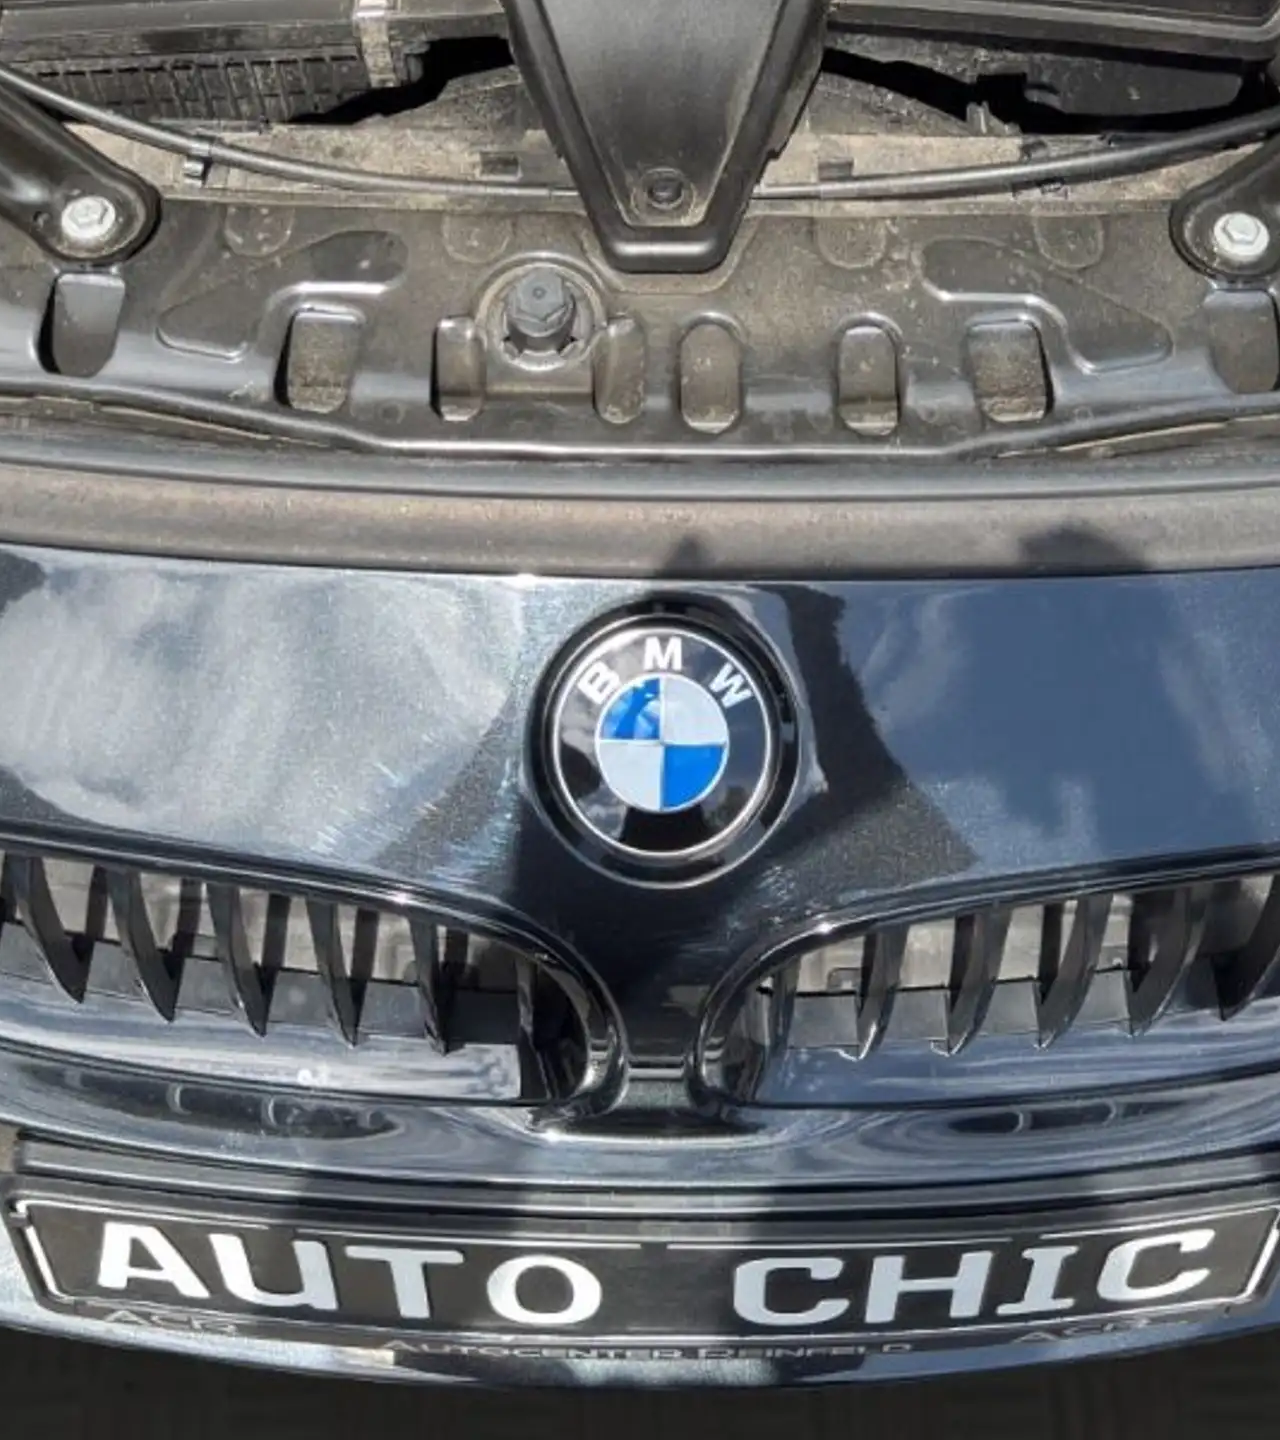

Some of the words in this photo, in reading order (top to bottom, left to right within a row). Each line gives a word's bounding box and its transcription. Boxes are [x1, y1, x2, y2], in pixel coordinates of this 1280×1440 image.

[577, 636, 755, 710] BMW
[96, 1221, 603, 1326] AUTO
[732, 1228, 1217, 1327] CHIC
